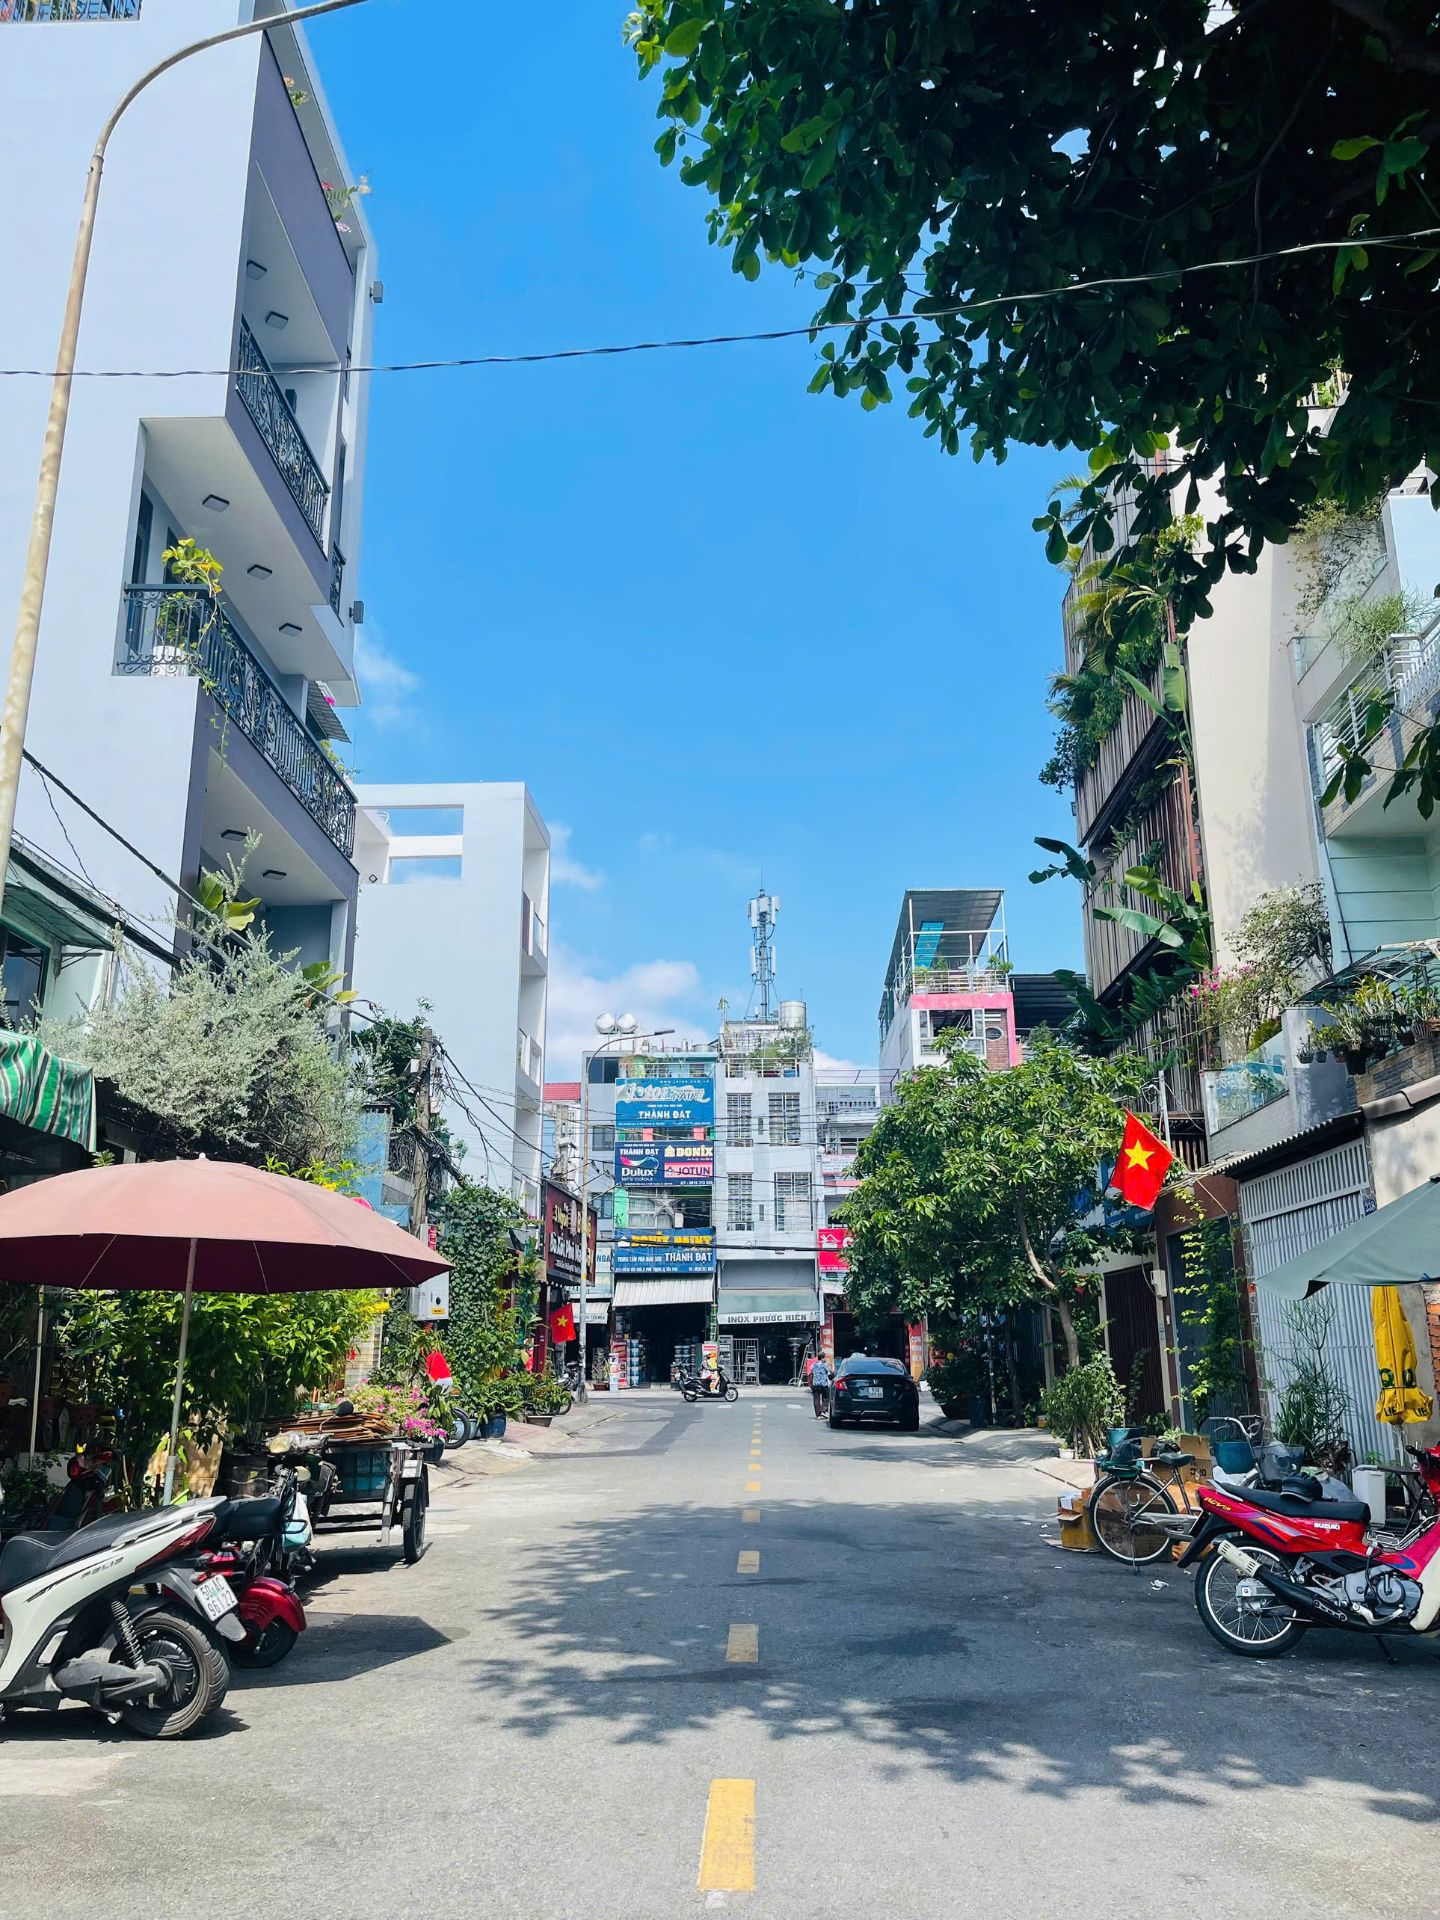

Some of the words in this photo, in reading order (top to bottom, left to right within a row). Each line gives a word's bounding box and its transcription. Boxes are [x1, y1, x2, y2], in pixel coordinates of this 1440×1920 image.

[638, 1109, 670, 1119] THÀNH
[672, 1110, 692, 1121] ĐẠT
[620, 1147, 645, 1155] THÀNH
[645, 1148, 659, 1156] ĐẠT
[621, 1168, 654, 1177] Dulux
[677, 1167, 710, 1175] JOTUN
[596, 1255, 611, 1263] NGA
[665, 1250, 693, 1262] THÀNH
[696, 1252, 713, 1264] ĐẠT
[728, 1315, 750, 1323] INOX
[1313, 1522, 1341, 1531] SUZUKI
